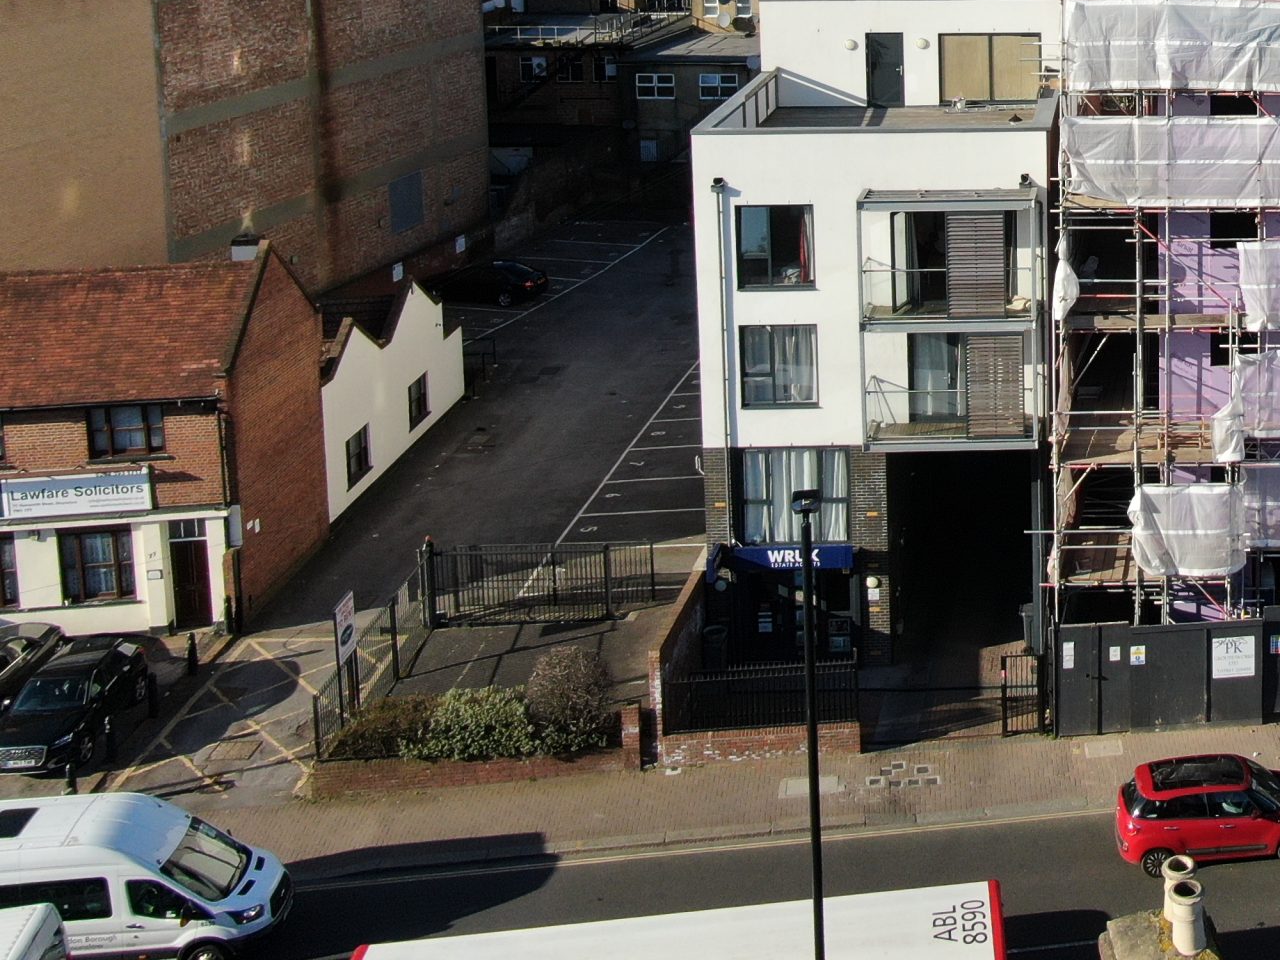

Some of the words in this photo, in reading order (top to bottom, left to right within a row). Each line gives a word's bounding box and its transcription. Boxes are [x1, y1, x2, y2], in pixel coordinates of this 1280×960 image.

[11, 487, 69, 501] Lawfare
[74, 484, 144, 498] Solicitors
[1225, 641, 1242, 654] PK
[932, 905, 959, 942] ABL
[960, 899, 988, 945] 8590
